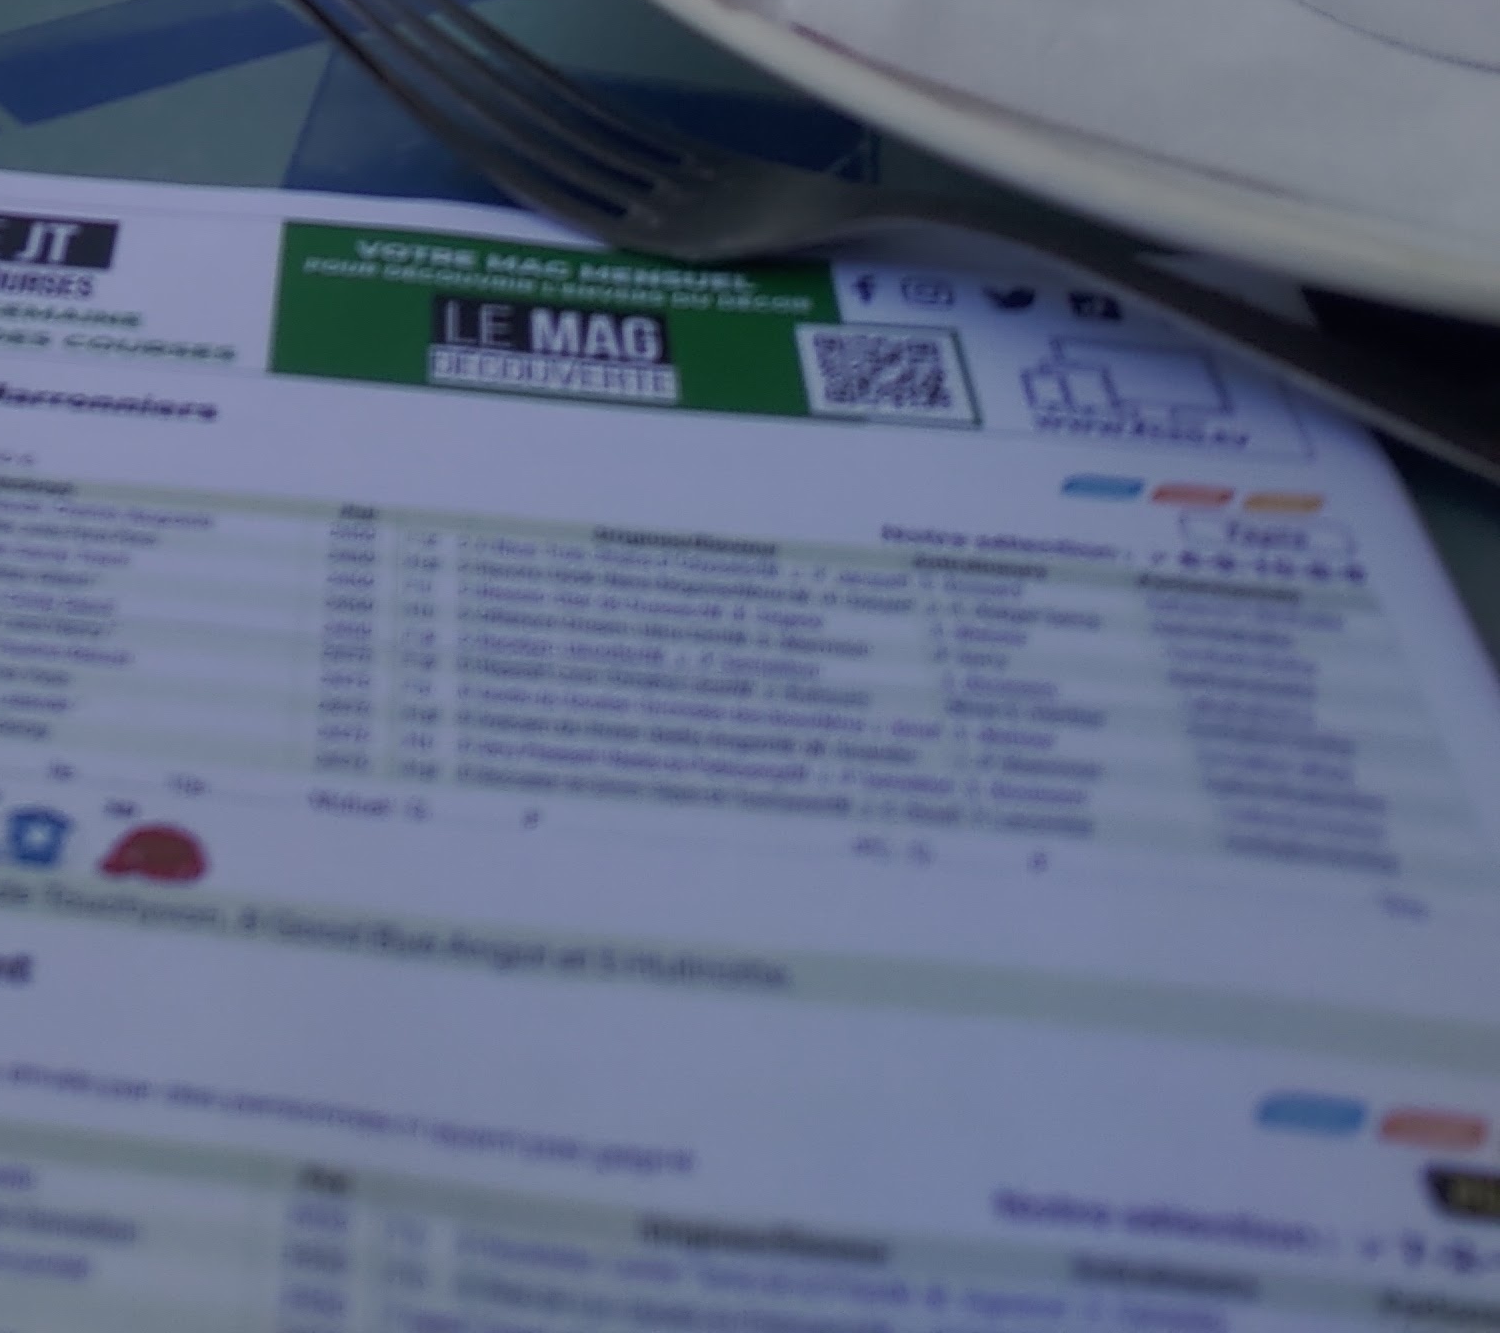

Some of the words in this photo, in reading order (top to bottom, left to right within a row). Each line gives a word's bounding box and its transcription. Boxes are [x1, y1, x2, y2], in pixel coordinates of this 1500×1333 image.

[14, 221, 82, 263] JT
[354, 239, 478, 270] VOTRE
[485, 252, 570, 282] MAG
[578, 262, 756, 295] MENSUEL
[444, 298, 518, 349] LE
[528, 305, 666, 364] MAG
